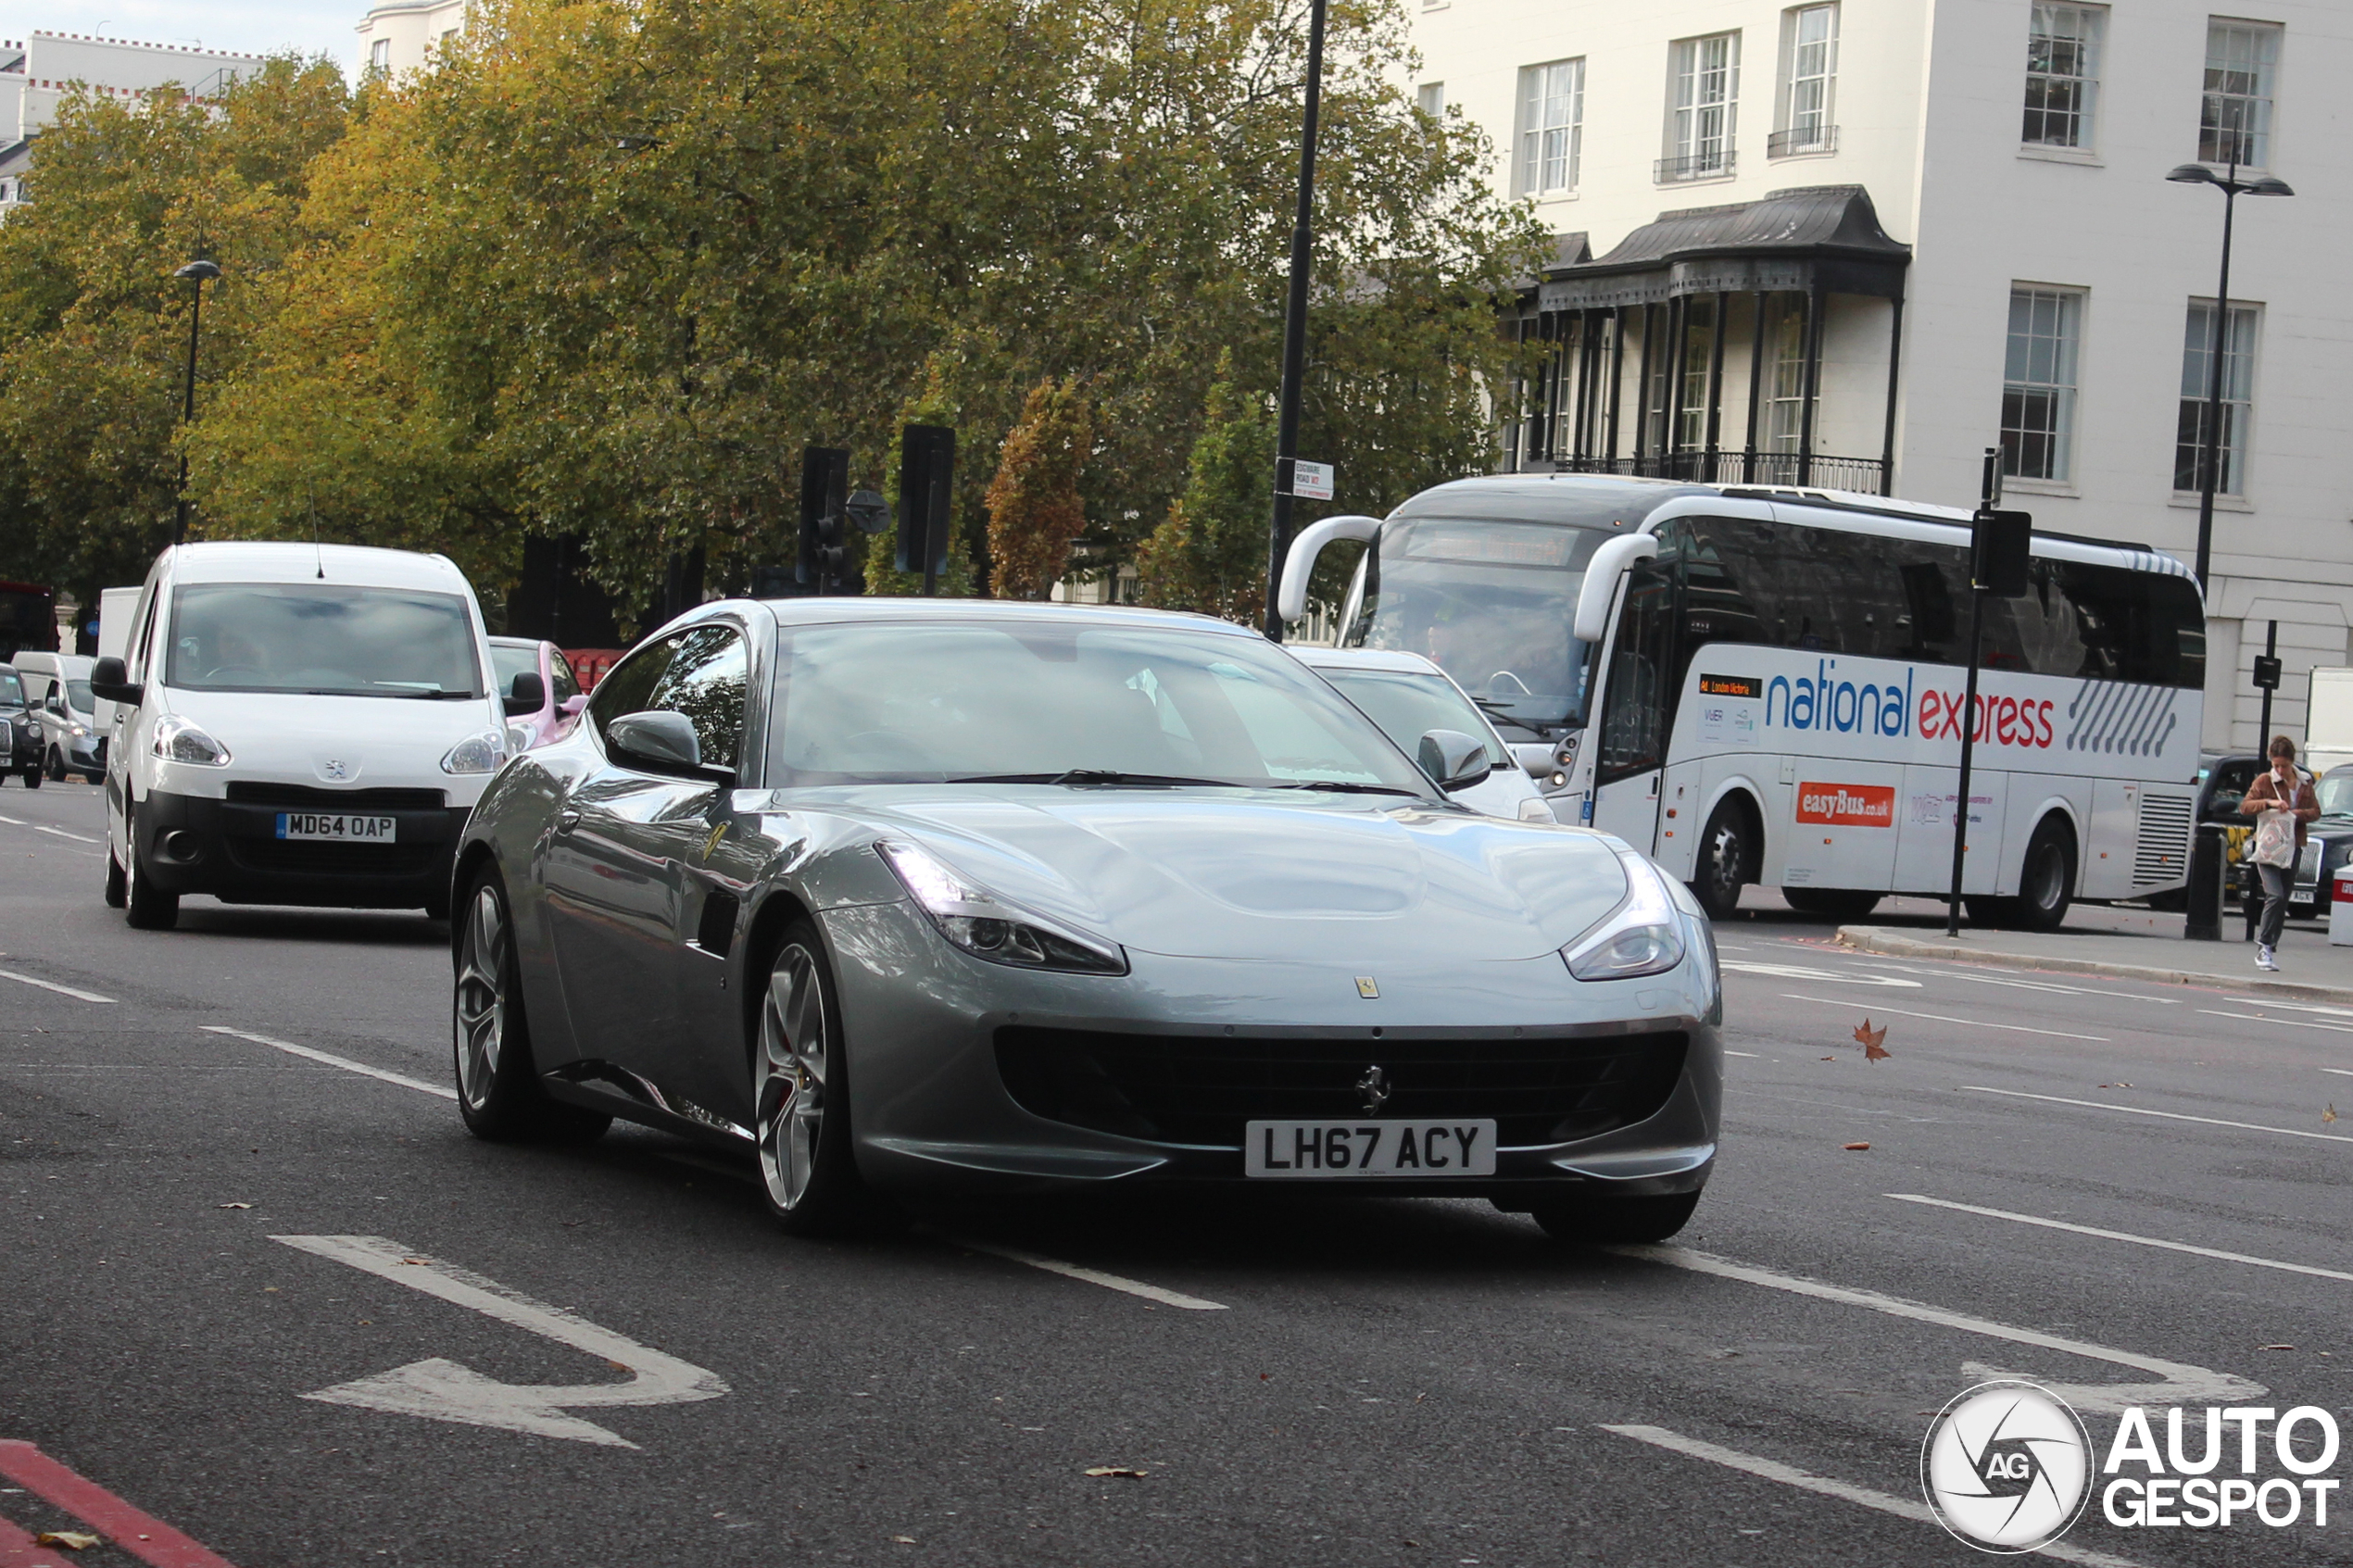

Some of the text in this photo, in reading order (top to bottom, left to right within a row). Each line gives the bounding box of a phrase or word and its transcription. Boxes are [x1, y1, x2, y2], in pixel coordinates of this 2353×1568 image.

[1296, 463, 1320, 474] EDGWARE
[1296, 473, 1310, 483] ROAD
[1711, 681, 1730, 693] London
[1730, 683, 1750, 696] Victoria
[1766, 658, 1914, 737] national
[1802, 789, 1889, 819] easyBus.co.uk
[290, 815, 392, 837] MD64 OAP
[1265, 1126, 1479, 1170] LH67 ACY
